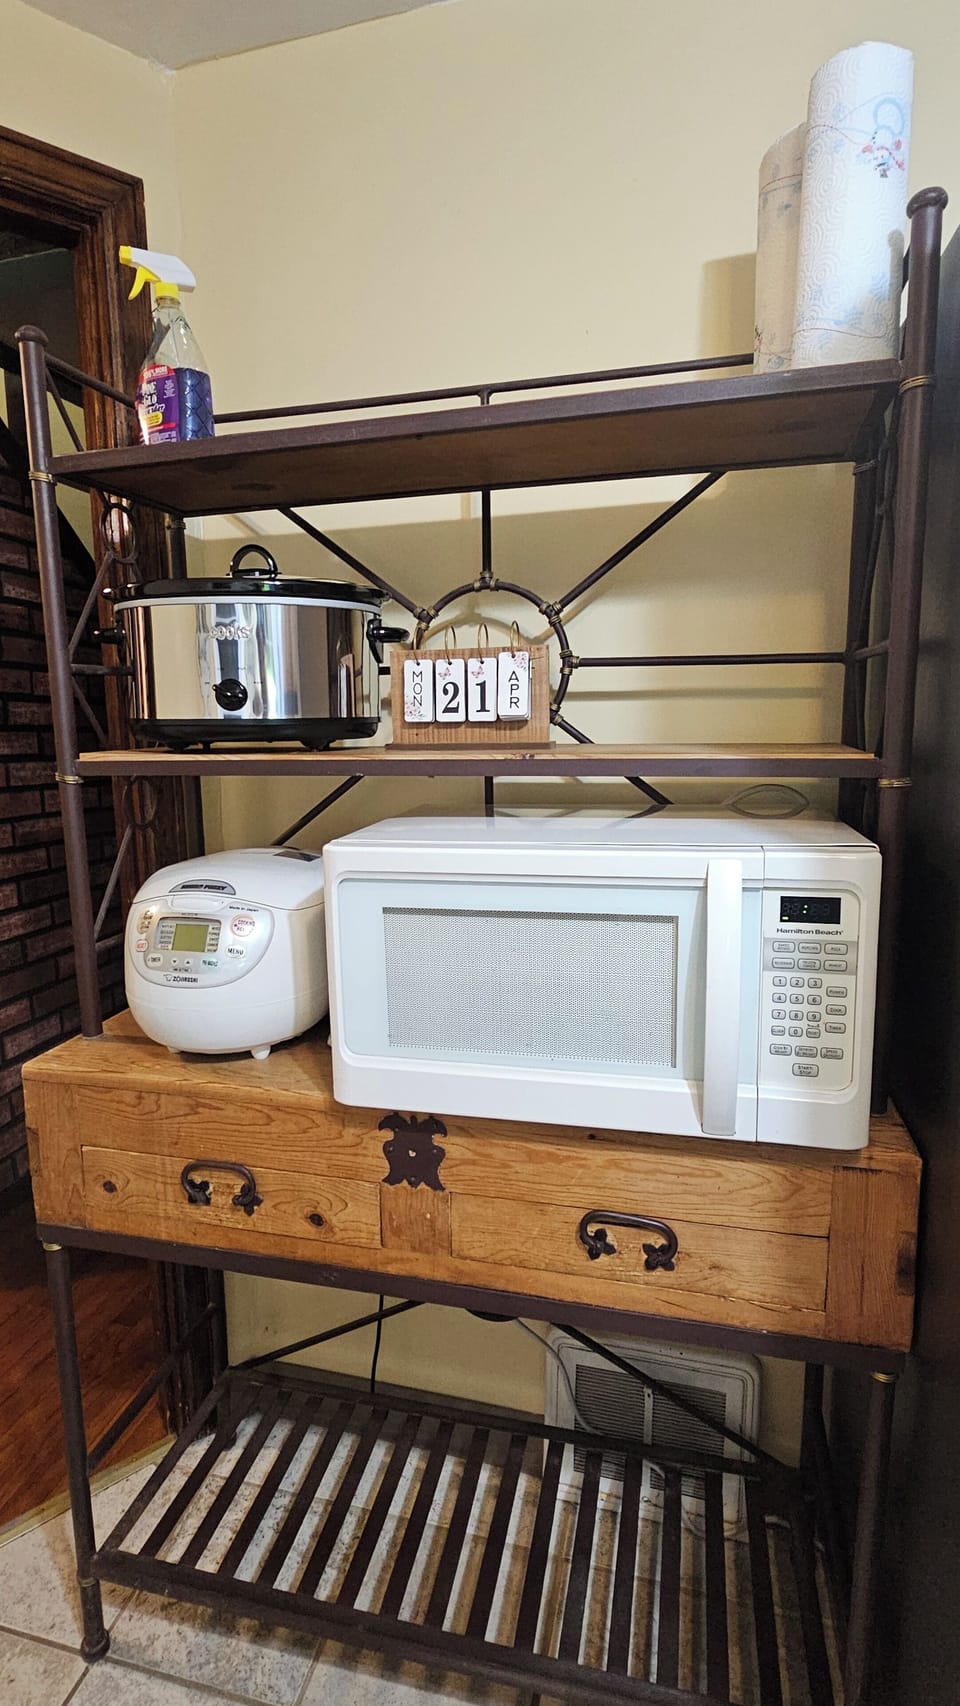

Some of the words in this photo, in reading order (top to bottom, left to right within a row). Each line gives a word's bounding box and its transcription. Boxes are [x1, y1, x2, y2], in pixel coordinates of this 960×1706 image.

[412, 670, 423, 707] MON
[508, 670, 520, 709] APR
[776, 927, 814, 935] Hamilton
[227, 947, 244, 956] MENU
